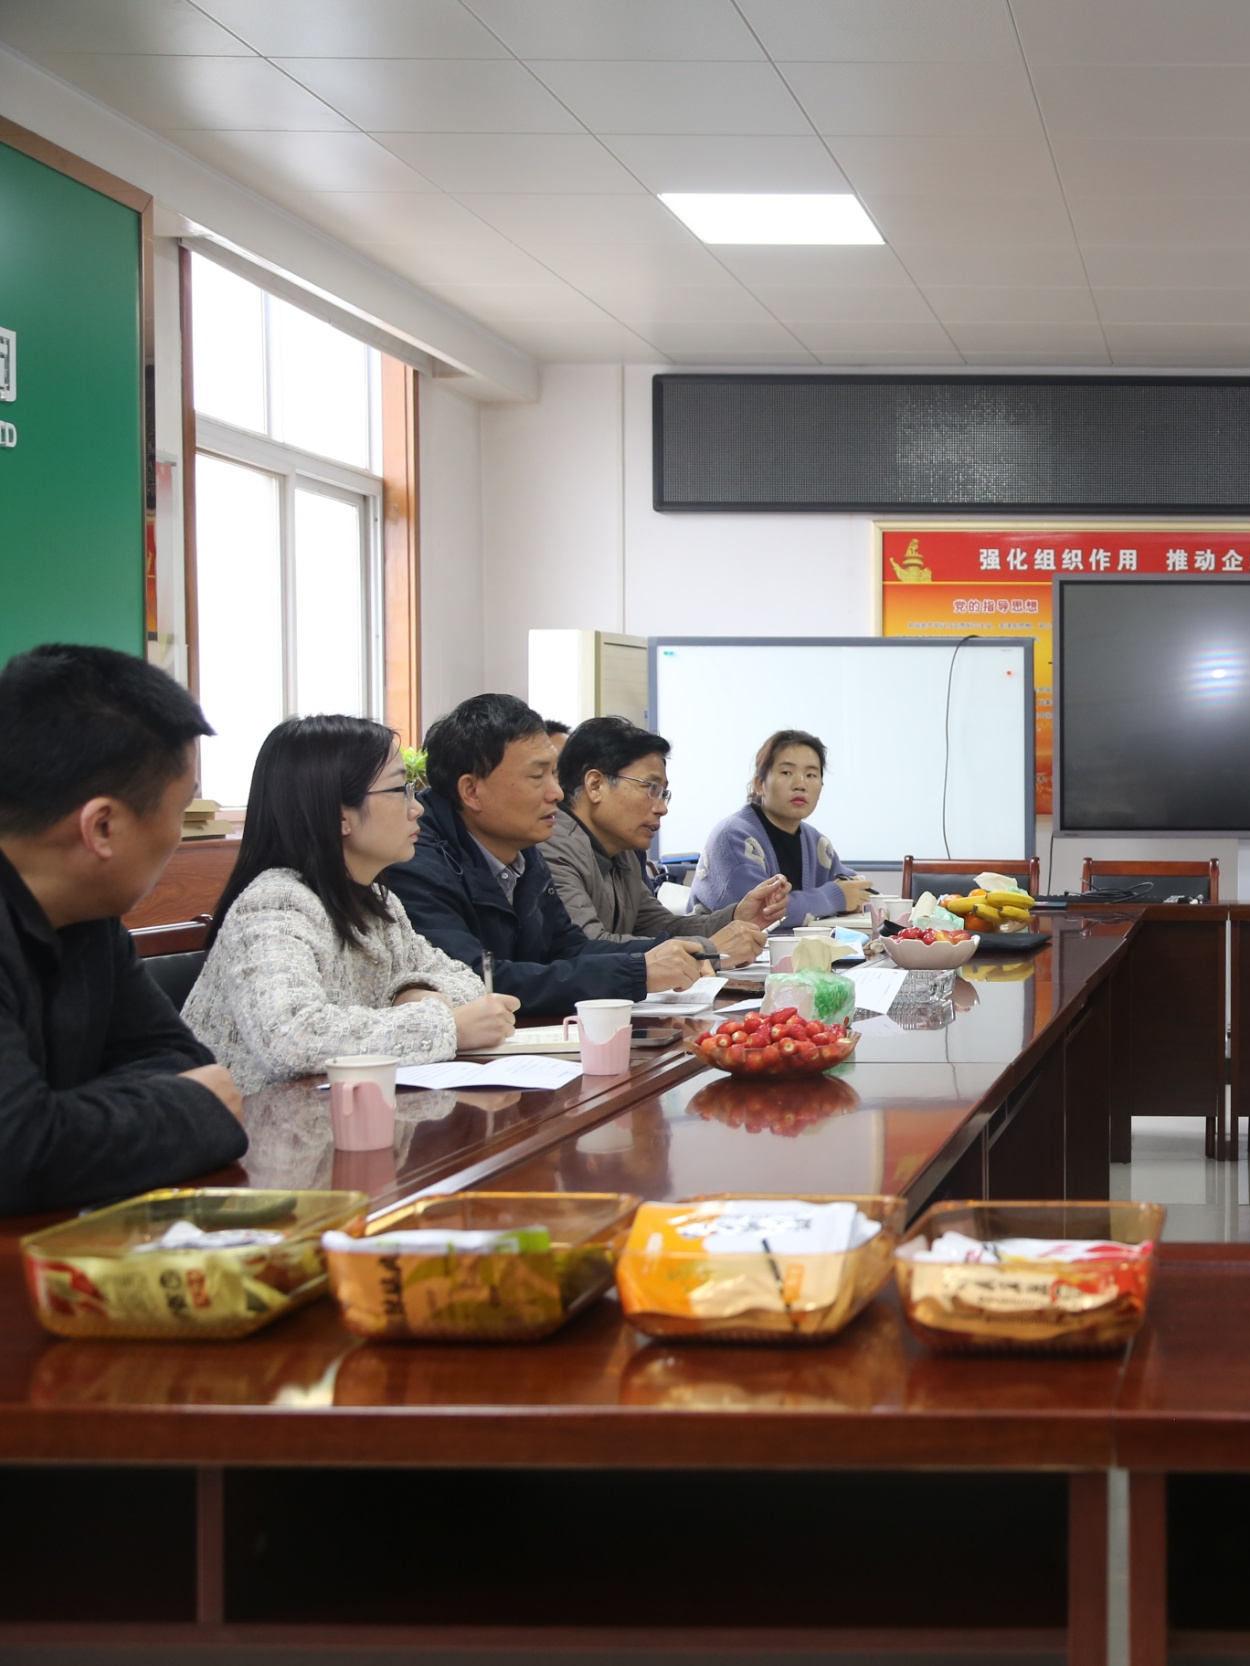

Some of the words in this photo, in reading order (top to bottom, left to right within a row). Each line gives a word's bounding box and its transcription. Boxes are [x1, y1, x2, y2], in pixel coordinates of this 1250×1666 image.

[979, 548, 1138, 571] 强化组织作用
[953, 599, 1038, 613] 党的指导思想
